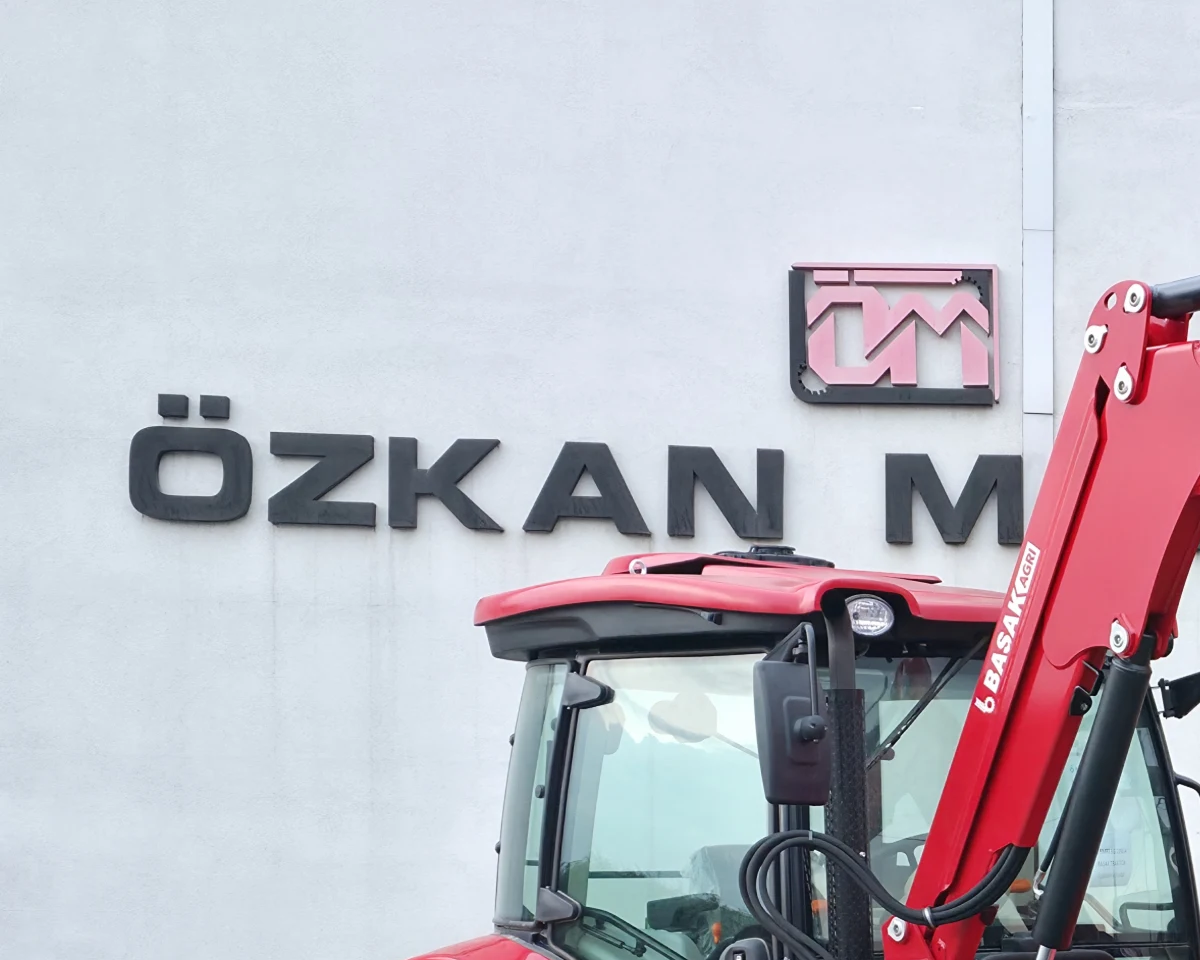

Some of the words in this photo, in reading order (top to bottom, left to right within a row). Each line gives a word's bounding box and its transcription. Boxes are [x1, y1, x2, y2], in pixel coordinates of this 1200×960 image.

[129, 393, 784, 541] ÖZKAN
[983, 587, 1028, 694] BASAK
[1019, 547, 1037, 590] AGRI
